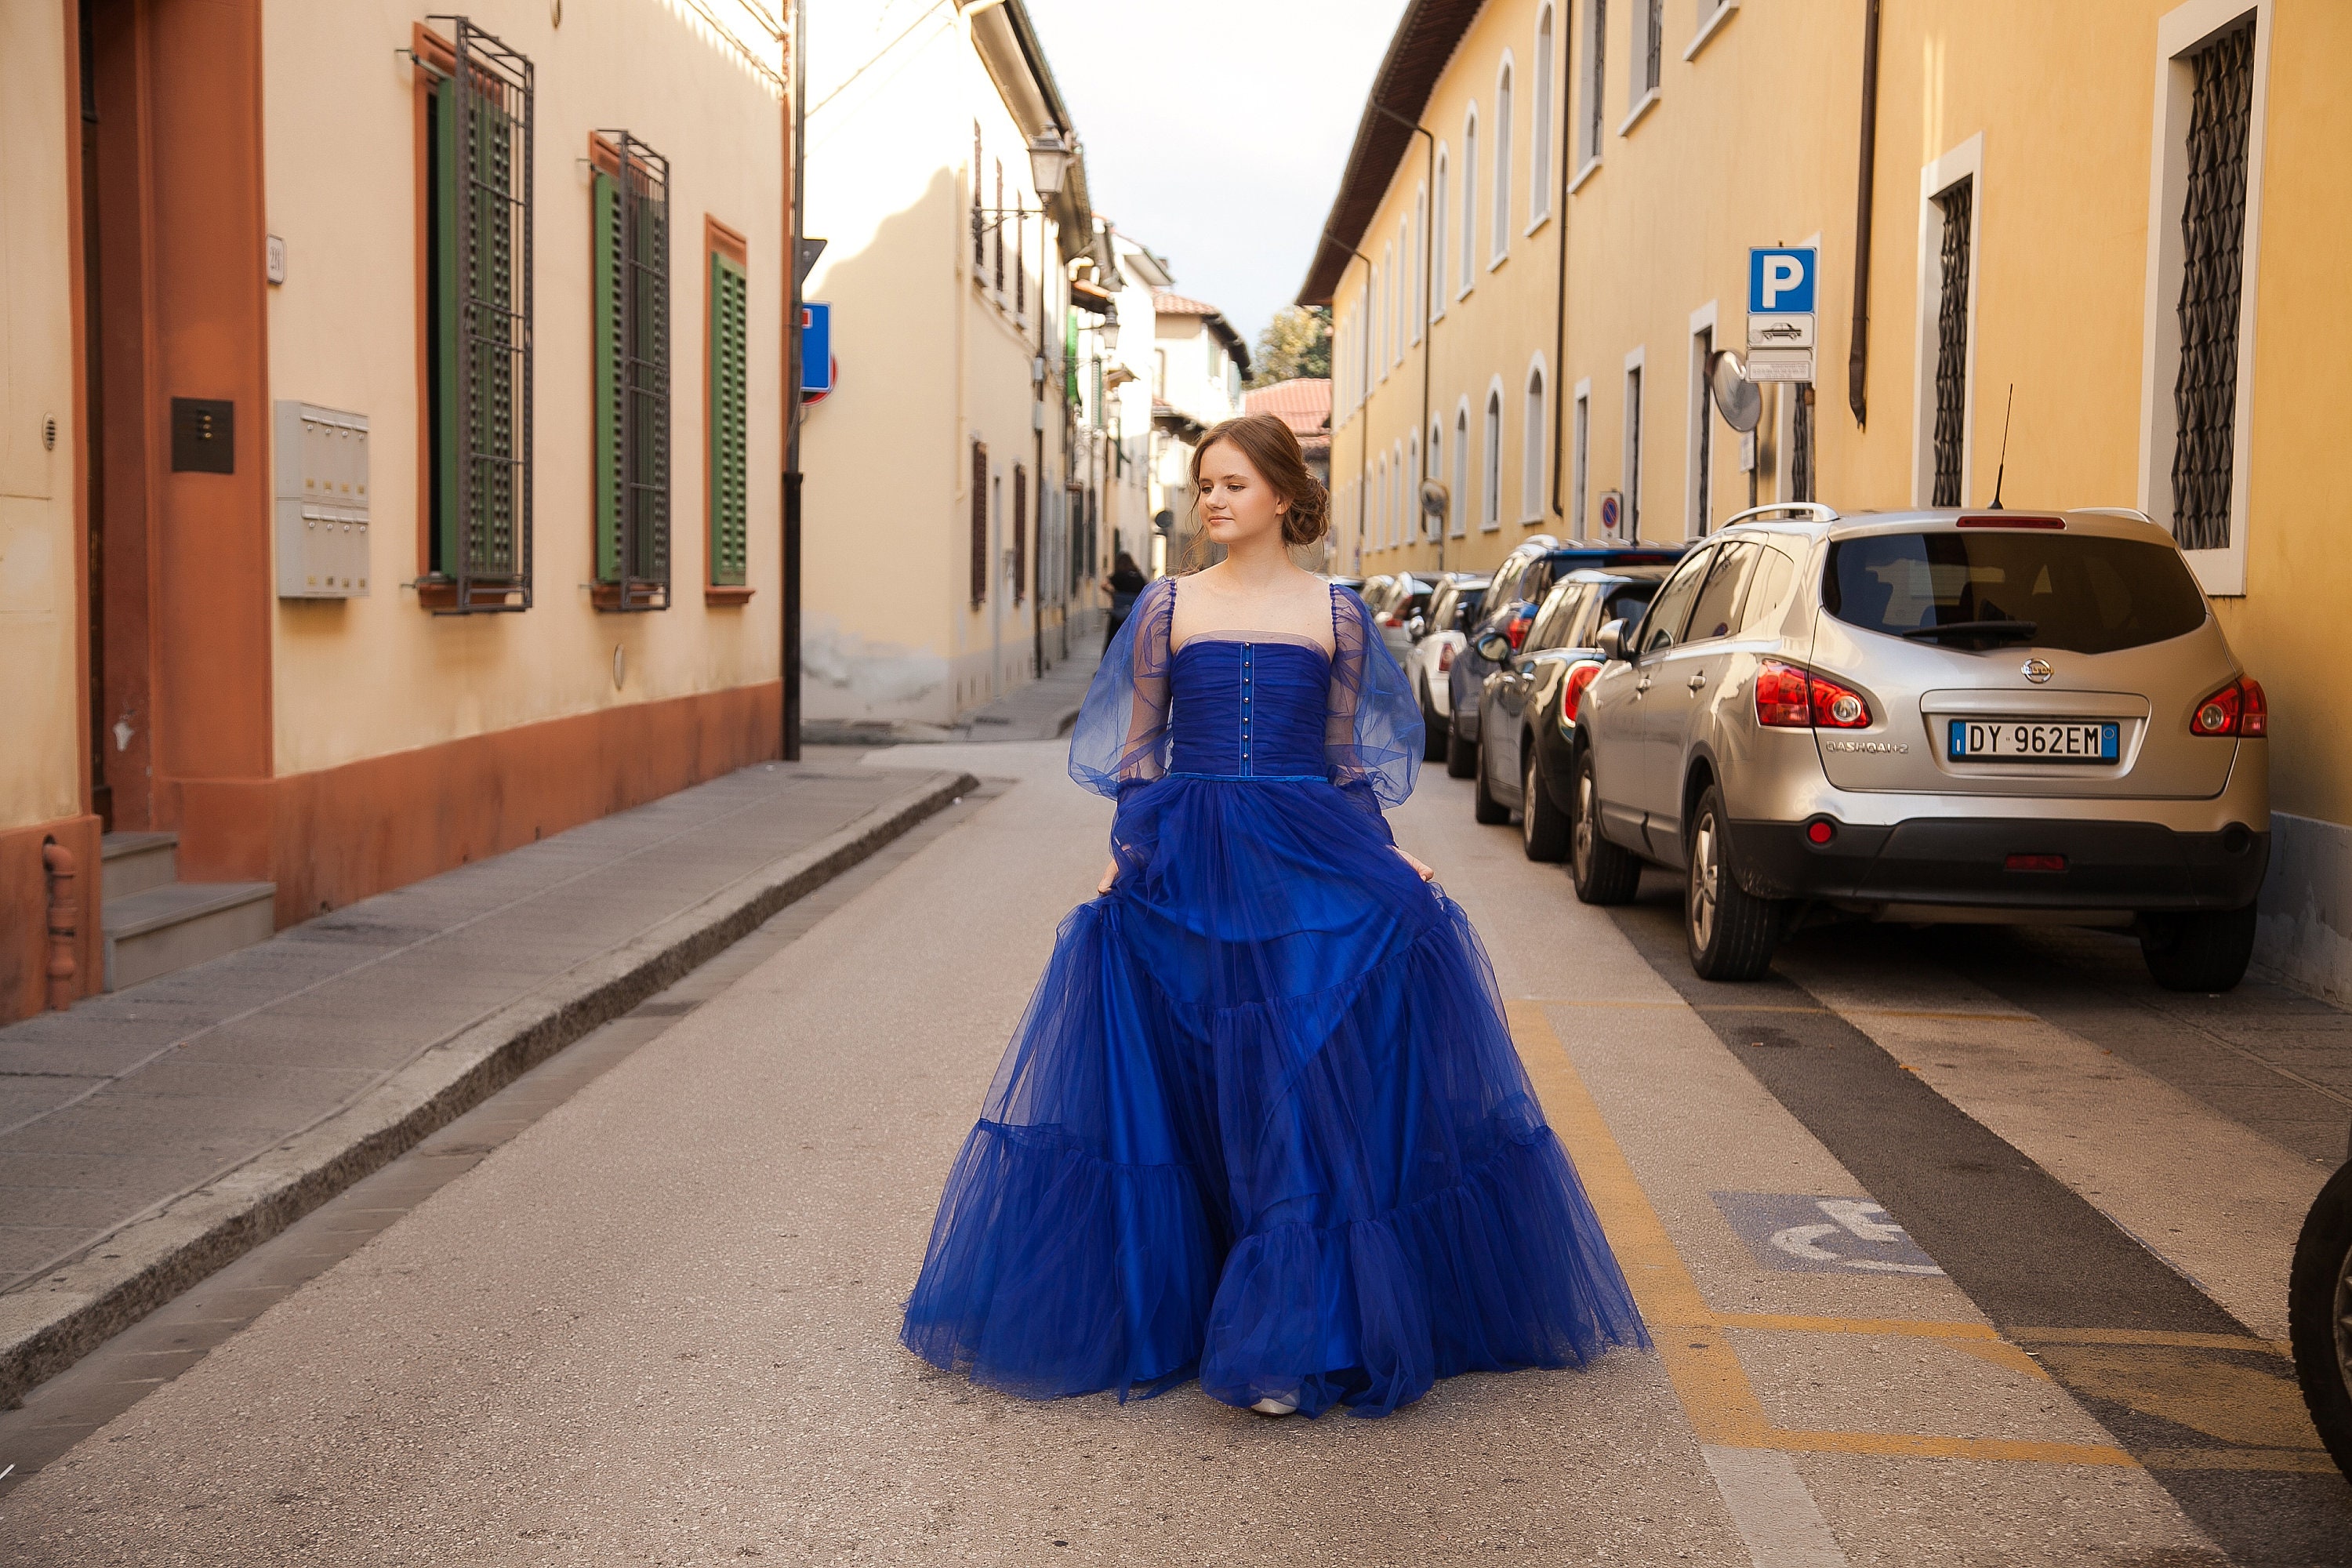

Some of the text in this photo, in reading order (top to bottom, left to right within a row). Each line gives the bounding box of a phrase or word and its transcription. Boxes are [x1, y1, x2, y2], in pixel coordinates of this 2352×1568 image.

[1762, 255, 1804, 308] P
[1969, 725, 2002, 753] DY
[2014, 726, 2099, 754] 962EM
